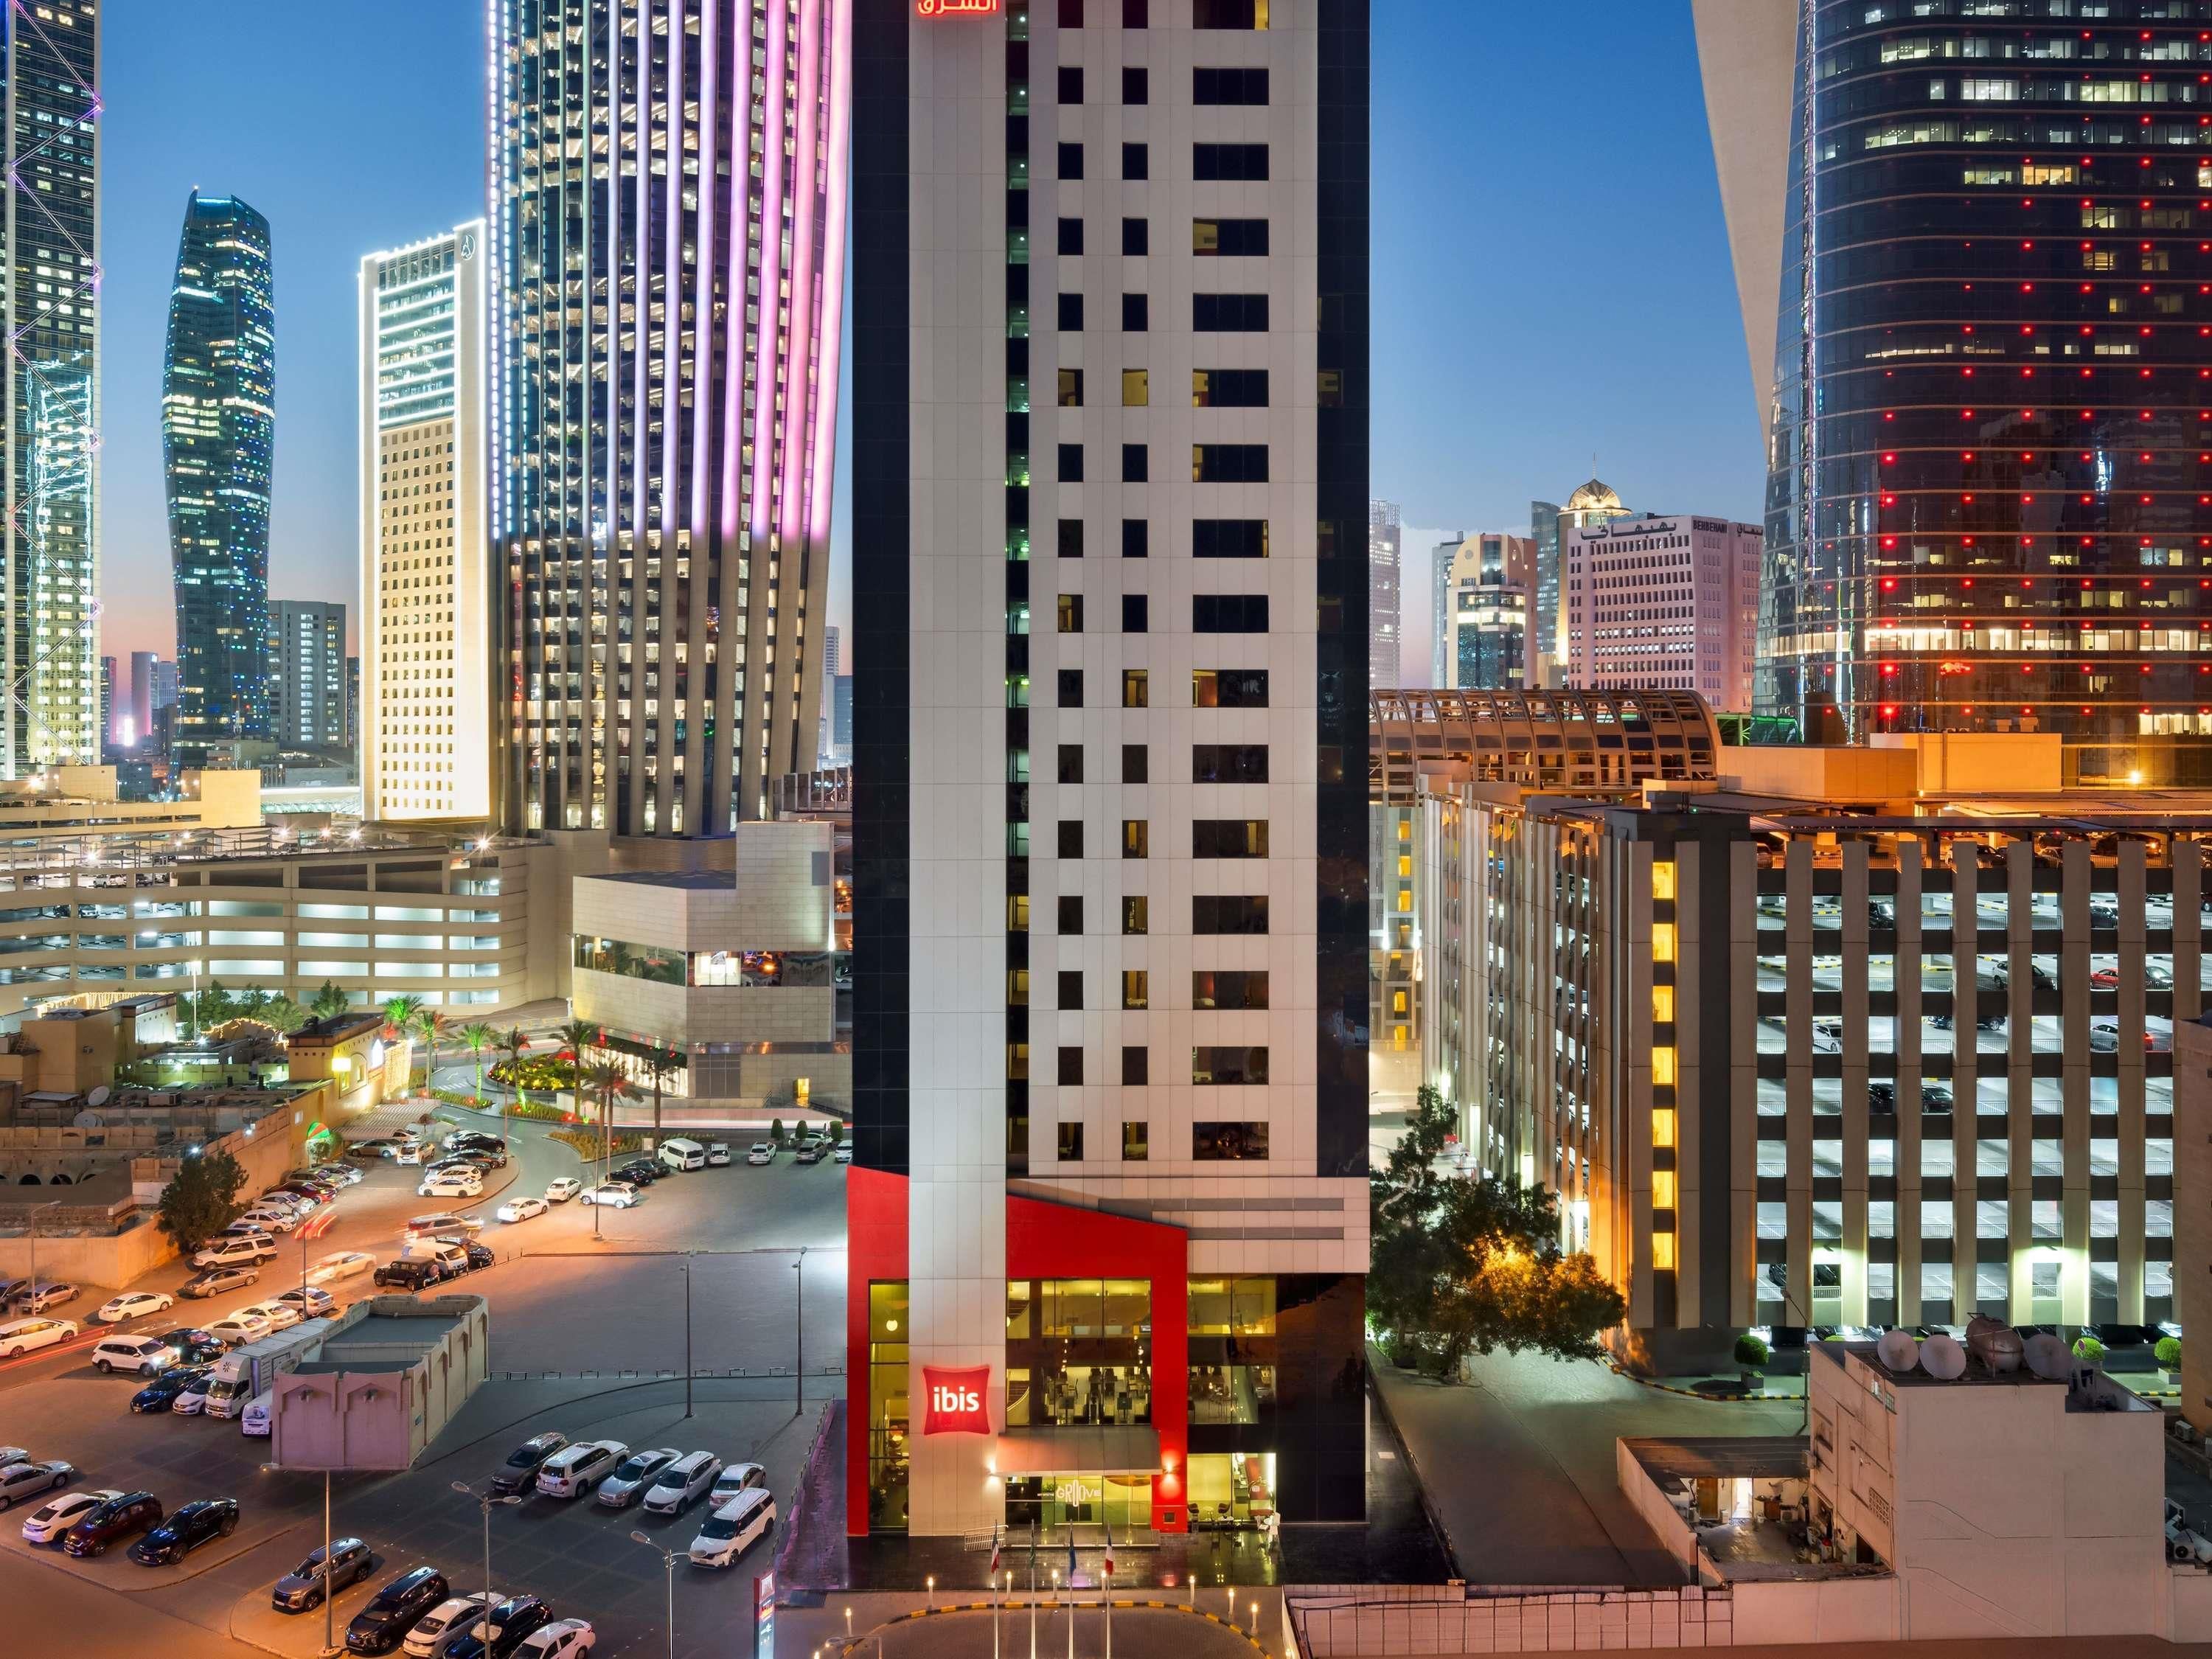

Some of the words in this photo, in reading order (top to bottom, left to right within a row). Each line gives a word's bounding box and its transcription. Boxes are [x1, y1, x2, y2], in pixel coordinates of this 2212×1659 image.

[1693, 520, 1728, 533] BEHBEHANI
[933, 1386, 979, 1413] ibis
[1057, 1480, 1102, 1507] GROOVE
